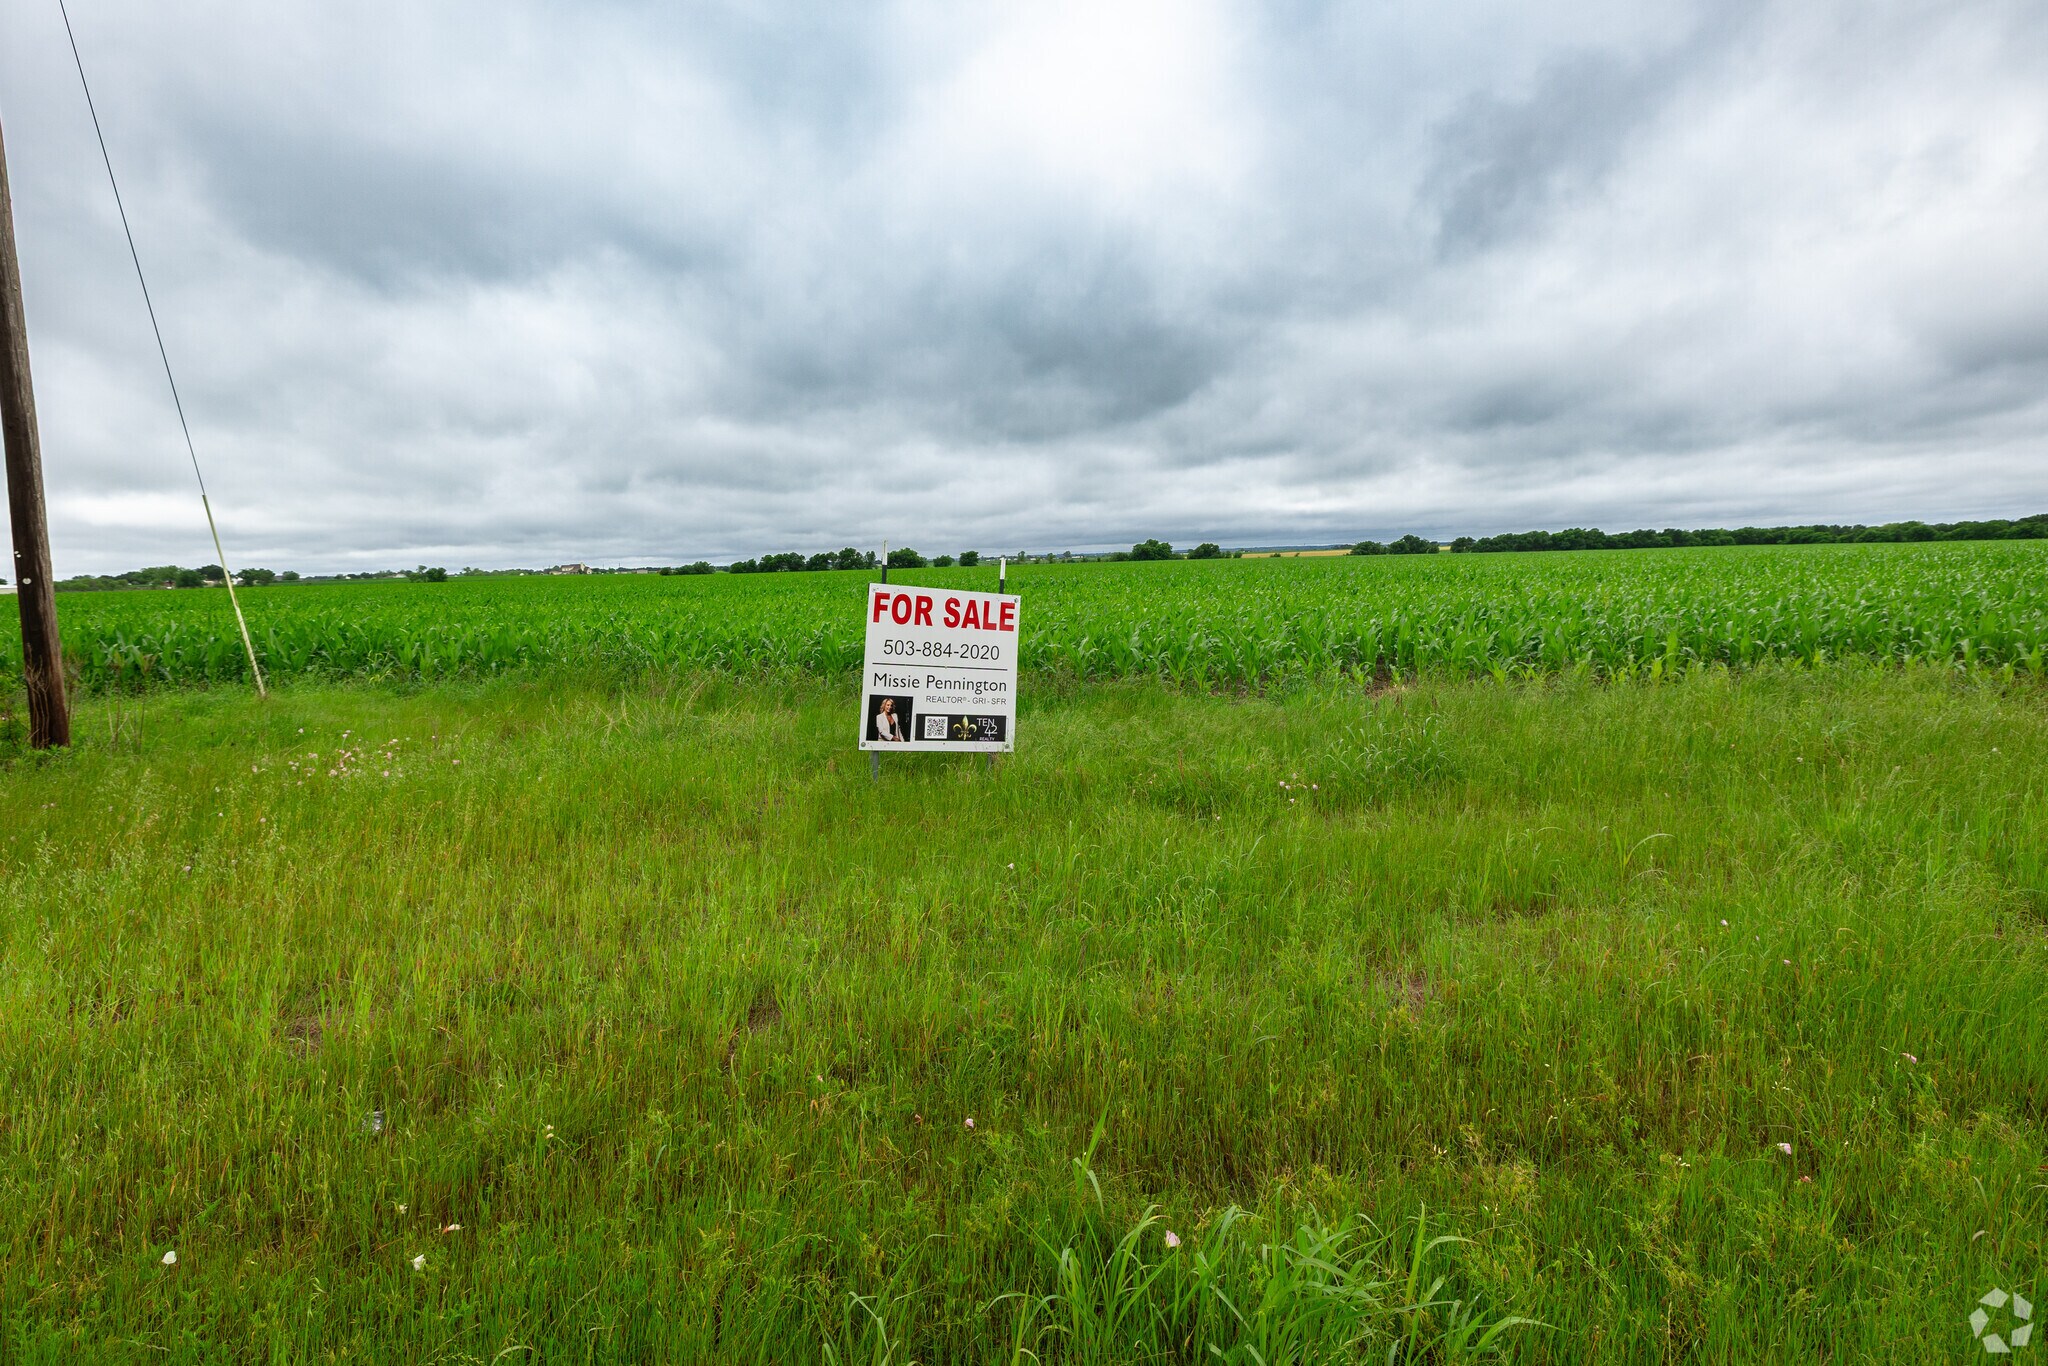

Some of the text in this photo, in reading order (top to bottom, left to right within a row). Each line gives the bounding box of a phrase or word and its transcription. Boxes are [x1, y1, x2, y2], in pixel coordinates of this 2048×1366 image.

[873, 592, 1016, 632] FOR SALE
[883, 639, 1000, 660] 503-884-2020
[873, 672, 1007, 695] Missie Pennington
[972, 697, 986, 705] GRI
[976, 717, 995, 727] TEN
